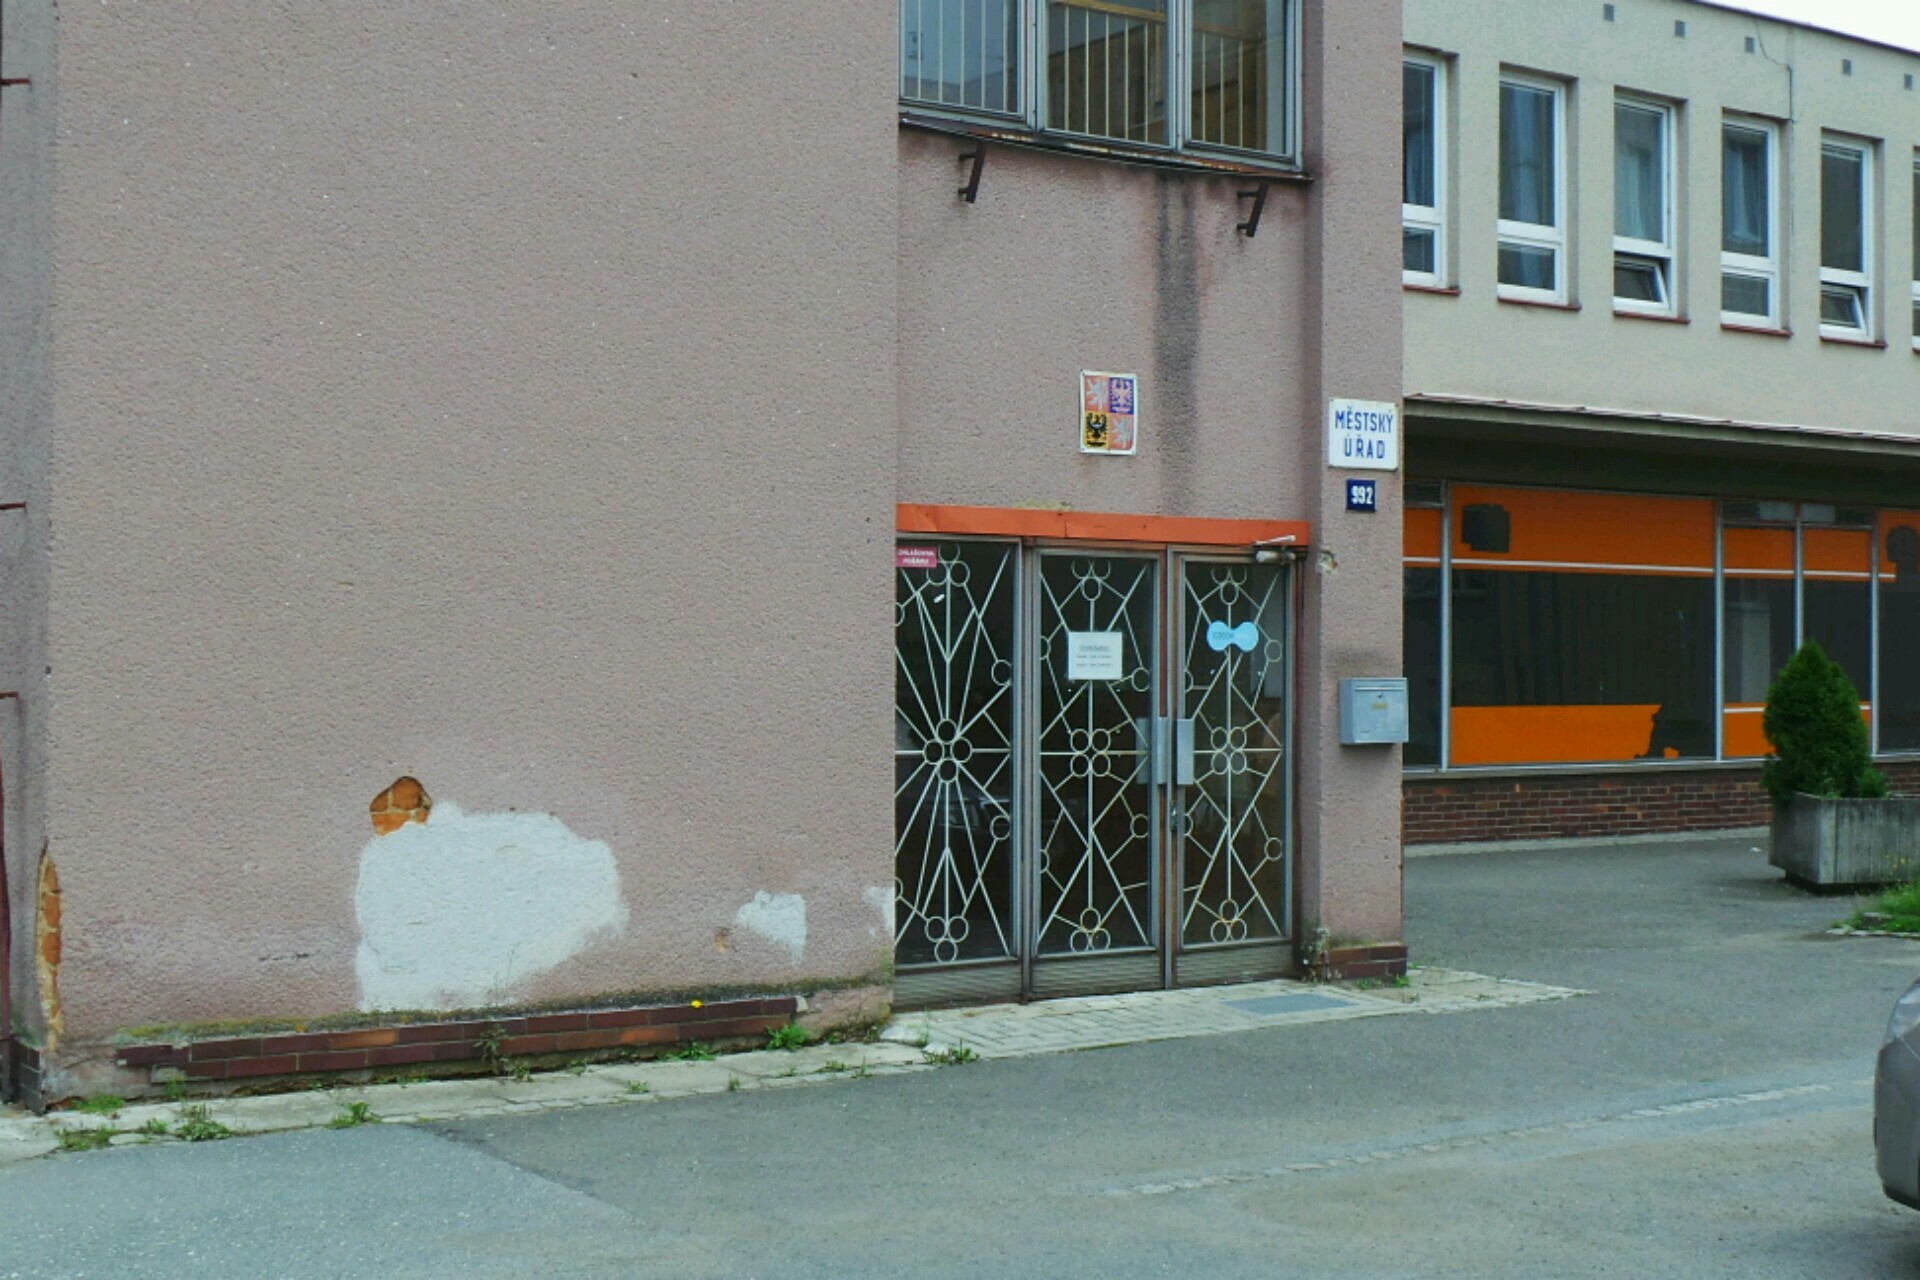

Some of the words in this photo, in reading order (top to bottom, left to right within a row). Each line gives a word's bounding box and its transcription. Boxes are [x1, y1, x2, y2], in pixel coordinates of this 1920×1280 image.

[1335, 406, 1393, 433] MĚSTSKÝ
[1344, 433, 1385, 459] ÚŘAD
[1351, 485, 1374, 504] 992
